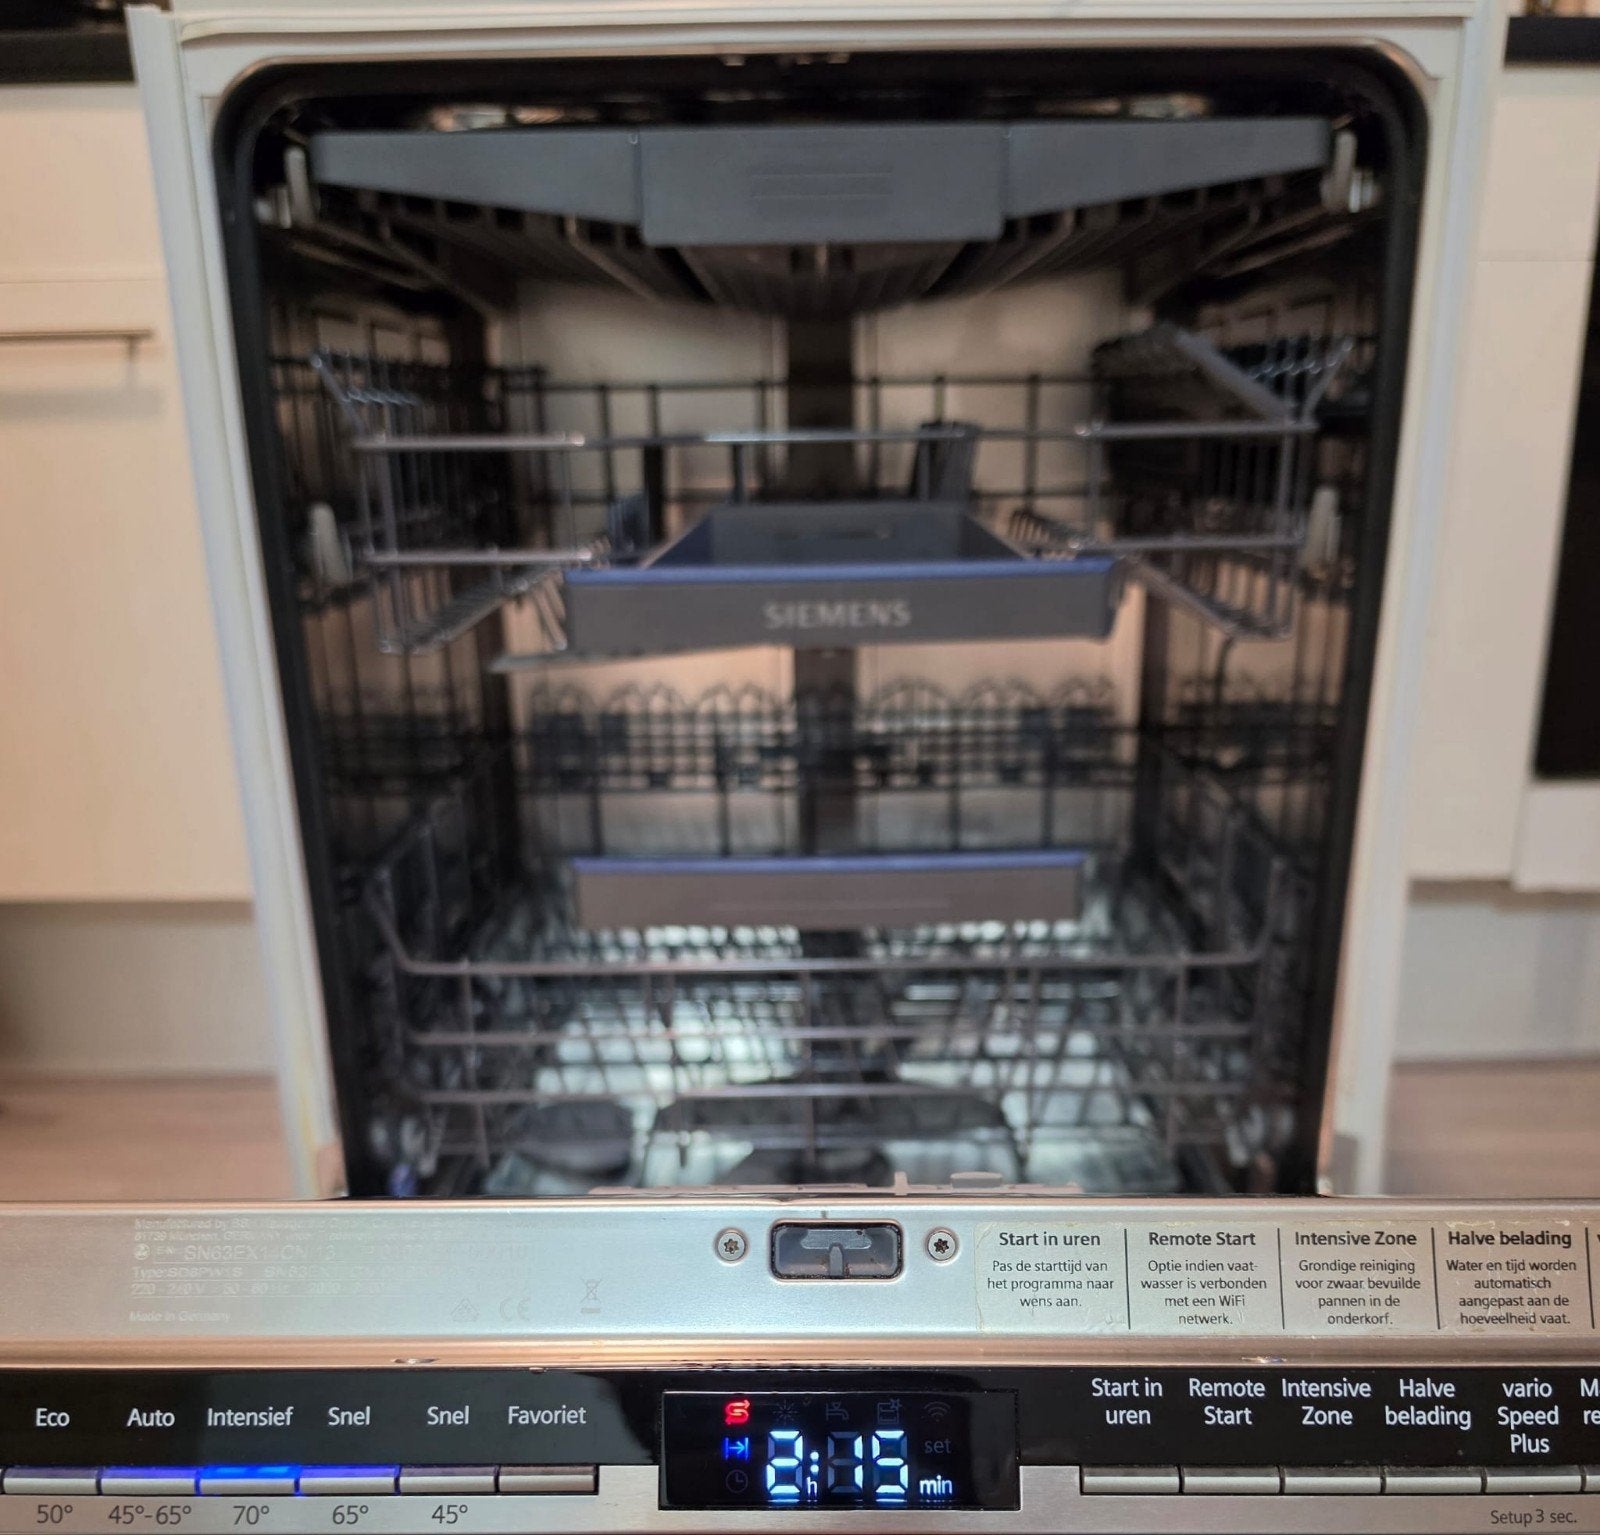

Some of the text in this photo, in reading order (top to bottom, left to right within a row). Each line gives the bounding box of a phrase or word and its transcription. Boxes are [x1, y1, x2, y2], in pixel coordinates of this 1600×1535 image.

[764, 601, 912, 628] SIEMENS
[999, 1231, 1101, 1246] Start in uren
[1149, 1232, 1256, 1246] Remote Start
[1295, 1231, 1417, 1246] Intensive Zone
[1448, 1230, 1572, 1249] Halve belading
[992, 1260, 1108, 1275] Pas de starttijd van
[1148, 1260, 1259, 1275] Optie indien vaat-
[1299, 1259, 1415, 1275] Grondige reiniging
[1446, 1259, 1577, 1274] Water en tijd worden
[987, 1277, 1114, 1293] het programma naar
[1140, 1277, 1267, 1289] wasser is verbonden
[1295, 1277, 1421, 1289] voor zwaar bevuilde
[1474, 1276, 1551, 1289] automatisch
[1020, 1297, 1082, 1307] wens aan.
[1164, 1294, 1245, 1307] met een WiFi
[1318, 1294, 1400, 1309] pannen in de
[1459, 1294, 1569, 1309] aangepast aan de
[1178, 1312, 1233, 1325] netwerk.
[1327, 1312, 1393, 1324] onderkorf.
[1460, 1312, 1571, 1324] hoeveelheid vaat.
[1091, 1377, 1163, 1397] Start in
[1189, 1378, 1266, 1397] Remote
[1282, 1377, 1371, 1398] Intensive
[1399, 1377, 1456, 1398] Halve
[1502, 1377, 1552, 1398] vario
[1580, 1378, 1600, 1397] M
[36, 1408, 70, 1427] Eco
[126, 1408, 175, 1427] Auto
[207, 1406, 293, 1426] Intensief
[328, 1406, 371, 1426] Snel
[427, 1406, 469, 1425] Snel
[508, 1405, 586, 1425] Favoriet
[1105, 1408, 1151, 1425] uren
[1204, 1406, 1252, 1425] Start
[1301, 1406, 1353, 1425] Zone
[1385, 1405, 1471, 1431] belading
[1497, 1405, 1559, 1430] Speed
[924, 1438, 950, 1453] set
[1510, 1433, 1550, 1453] Plus
[919, 1475, 952, 1495] min
[36, 1504, 73, 1524] 50°
[108, 1504, 192, 1525] 45°-65°
[233, 1504, 270, 1525] 70°
[332, 1504, 369, 1525] 65°
[431, 1504, 468, 1524] 45°
[1490, 1509, 1577, 1527] Setup 3 sec.
